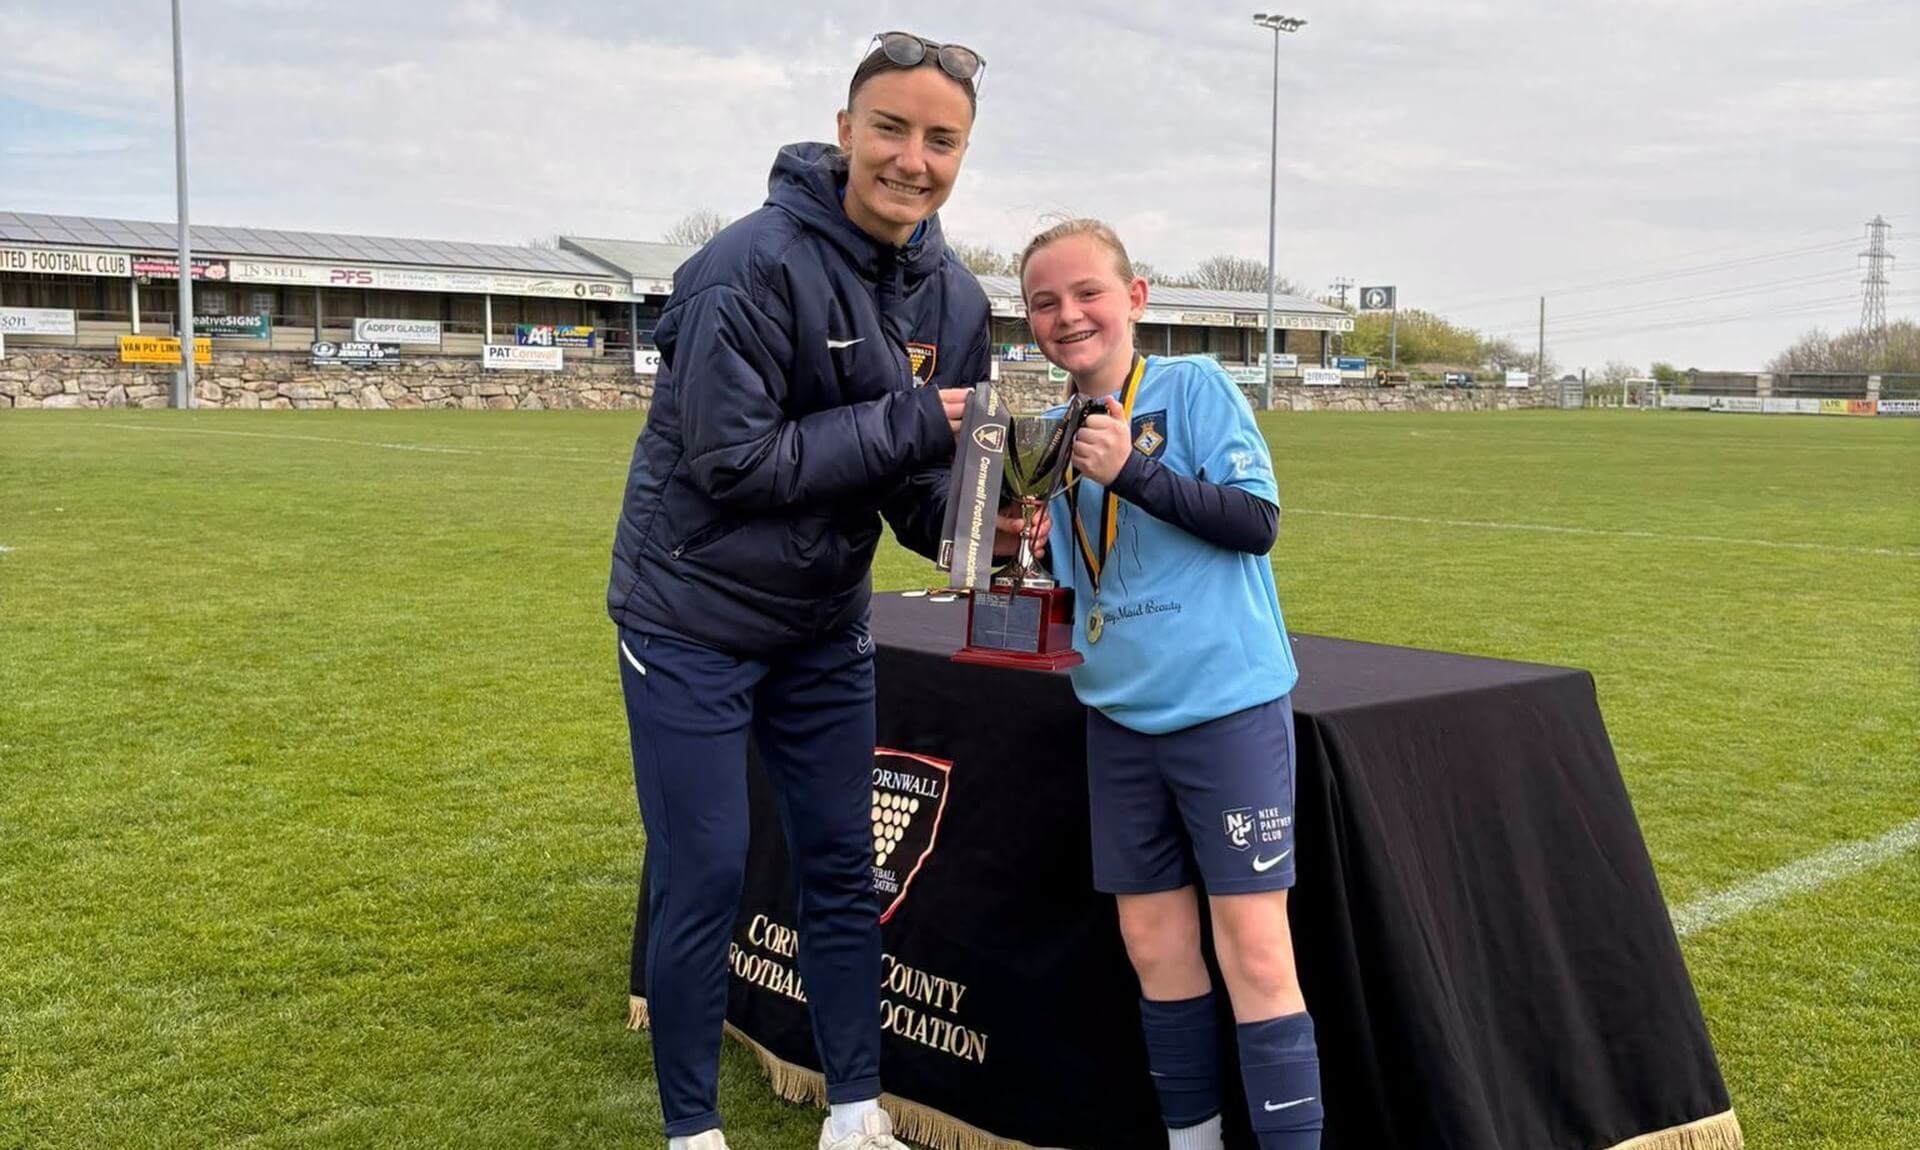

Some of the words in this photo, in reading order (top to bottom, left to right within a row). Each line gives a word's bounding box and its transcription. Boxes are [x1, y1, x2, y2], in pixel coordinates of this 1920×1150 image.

[32, 252, 92, 272] FOOTBALL
[96, 256, 126, 274] CLUB
[330, 270, 373, 284] PFS
[193, 315, 262, 327] eativeSIGNS
[366, 324, 395, 333] ADEPT
[397, 325, 438, 334] GLAZIERS
[123, 343, 140, 353] VAN
[143, 344, 158, 353] PLY
[161, 344, 181, 353] LININ
[975, 456, 991, 500] Cornwall
[970, 499, 985, 540] Football
[872, 767, 940, 799] ORNWALL
[1258, 807, 1279, 819] NIKE
[1261, 829, 1282, 842] CLUB
[748, 913, 799, 958] CORN
[880, 999, 988, 1064] OCIATION
